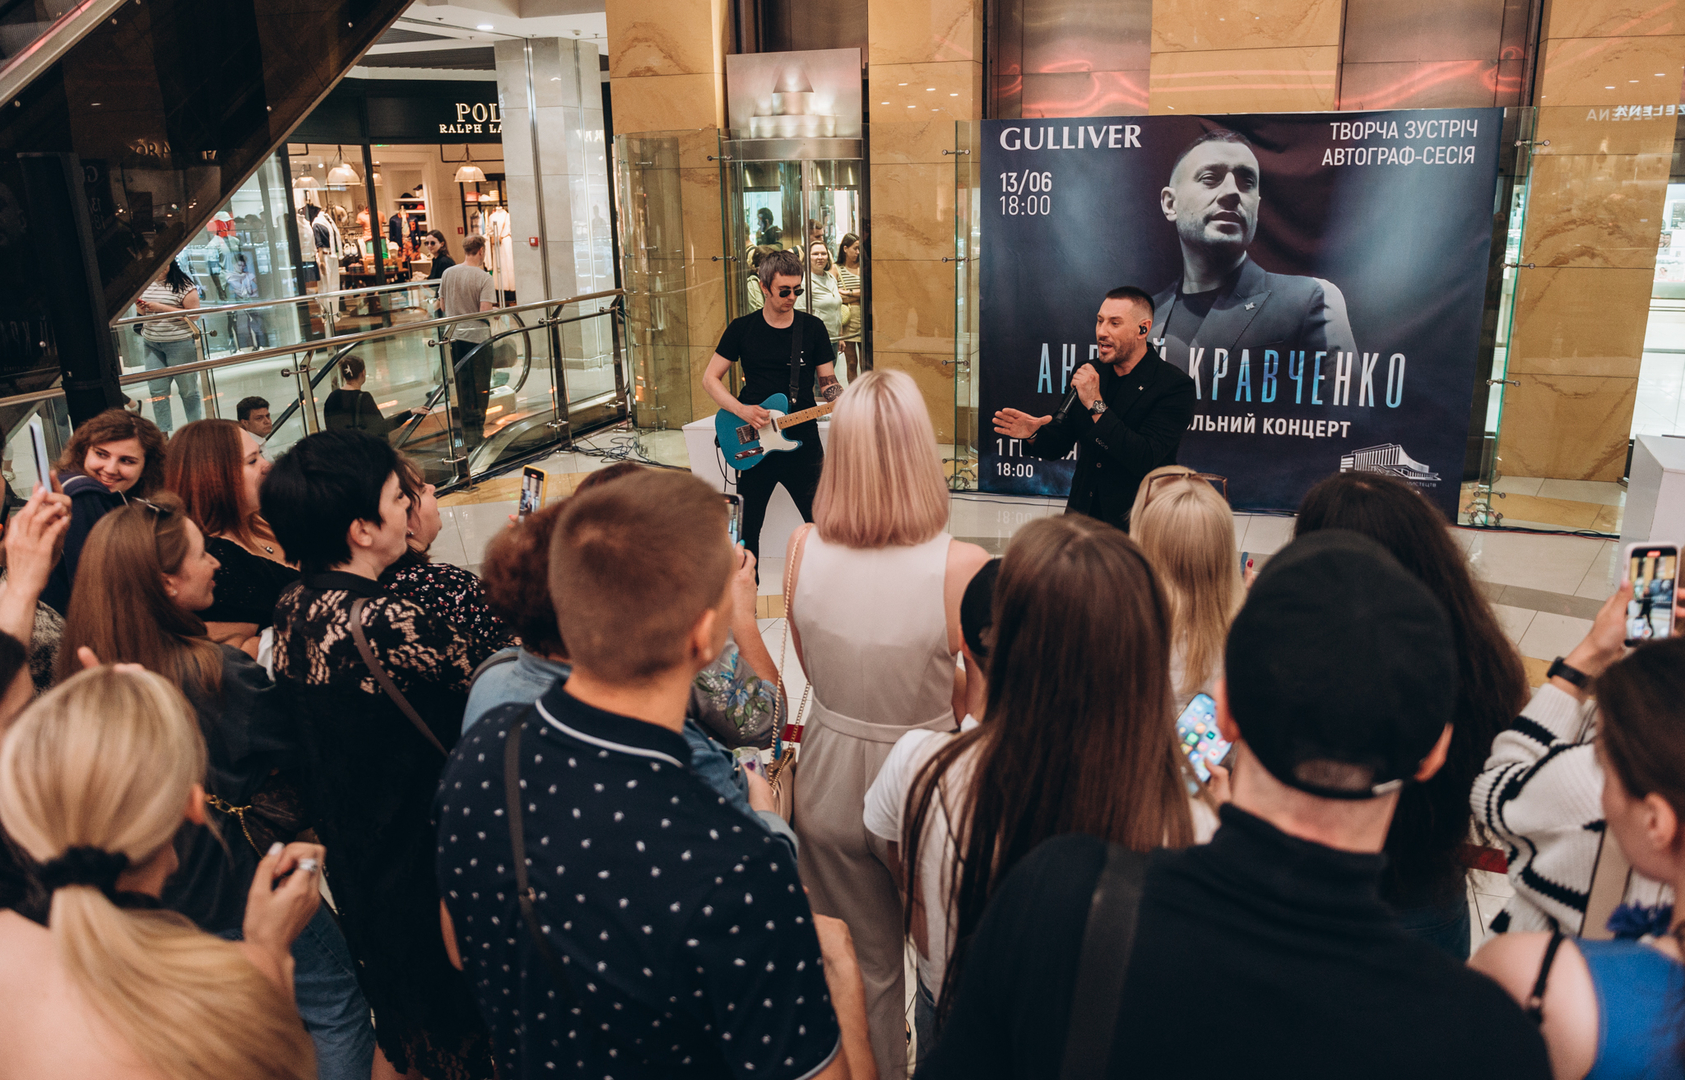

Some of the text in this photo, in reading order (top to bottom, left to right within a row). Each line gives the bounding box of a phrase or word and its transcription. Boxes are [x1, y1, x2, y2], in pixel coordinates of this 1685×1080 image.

[439, 124, 483, 134] RALPH
[1000, 124, 1142, 151] GULLIVER
[1330, 119, 1479, 141] ТВОРЧА ЗУСТРІЧ
[1321, 145, 1476, 166] АВТОГРАФ-СЕСІЯ
[1000, 169, 1052, 195] 13/06
[1000, 195, 1051, 215] 18:00
[1188, 347, 1406, 408] КРАВЧЕНКО
[1187, 412, 1352, 439] ЛЬНИЙ КОНЦЕРТ
[996, 462, 1034, 478] 18:00
